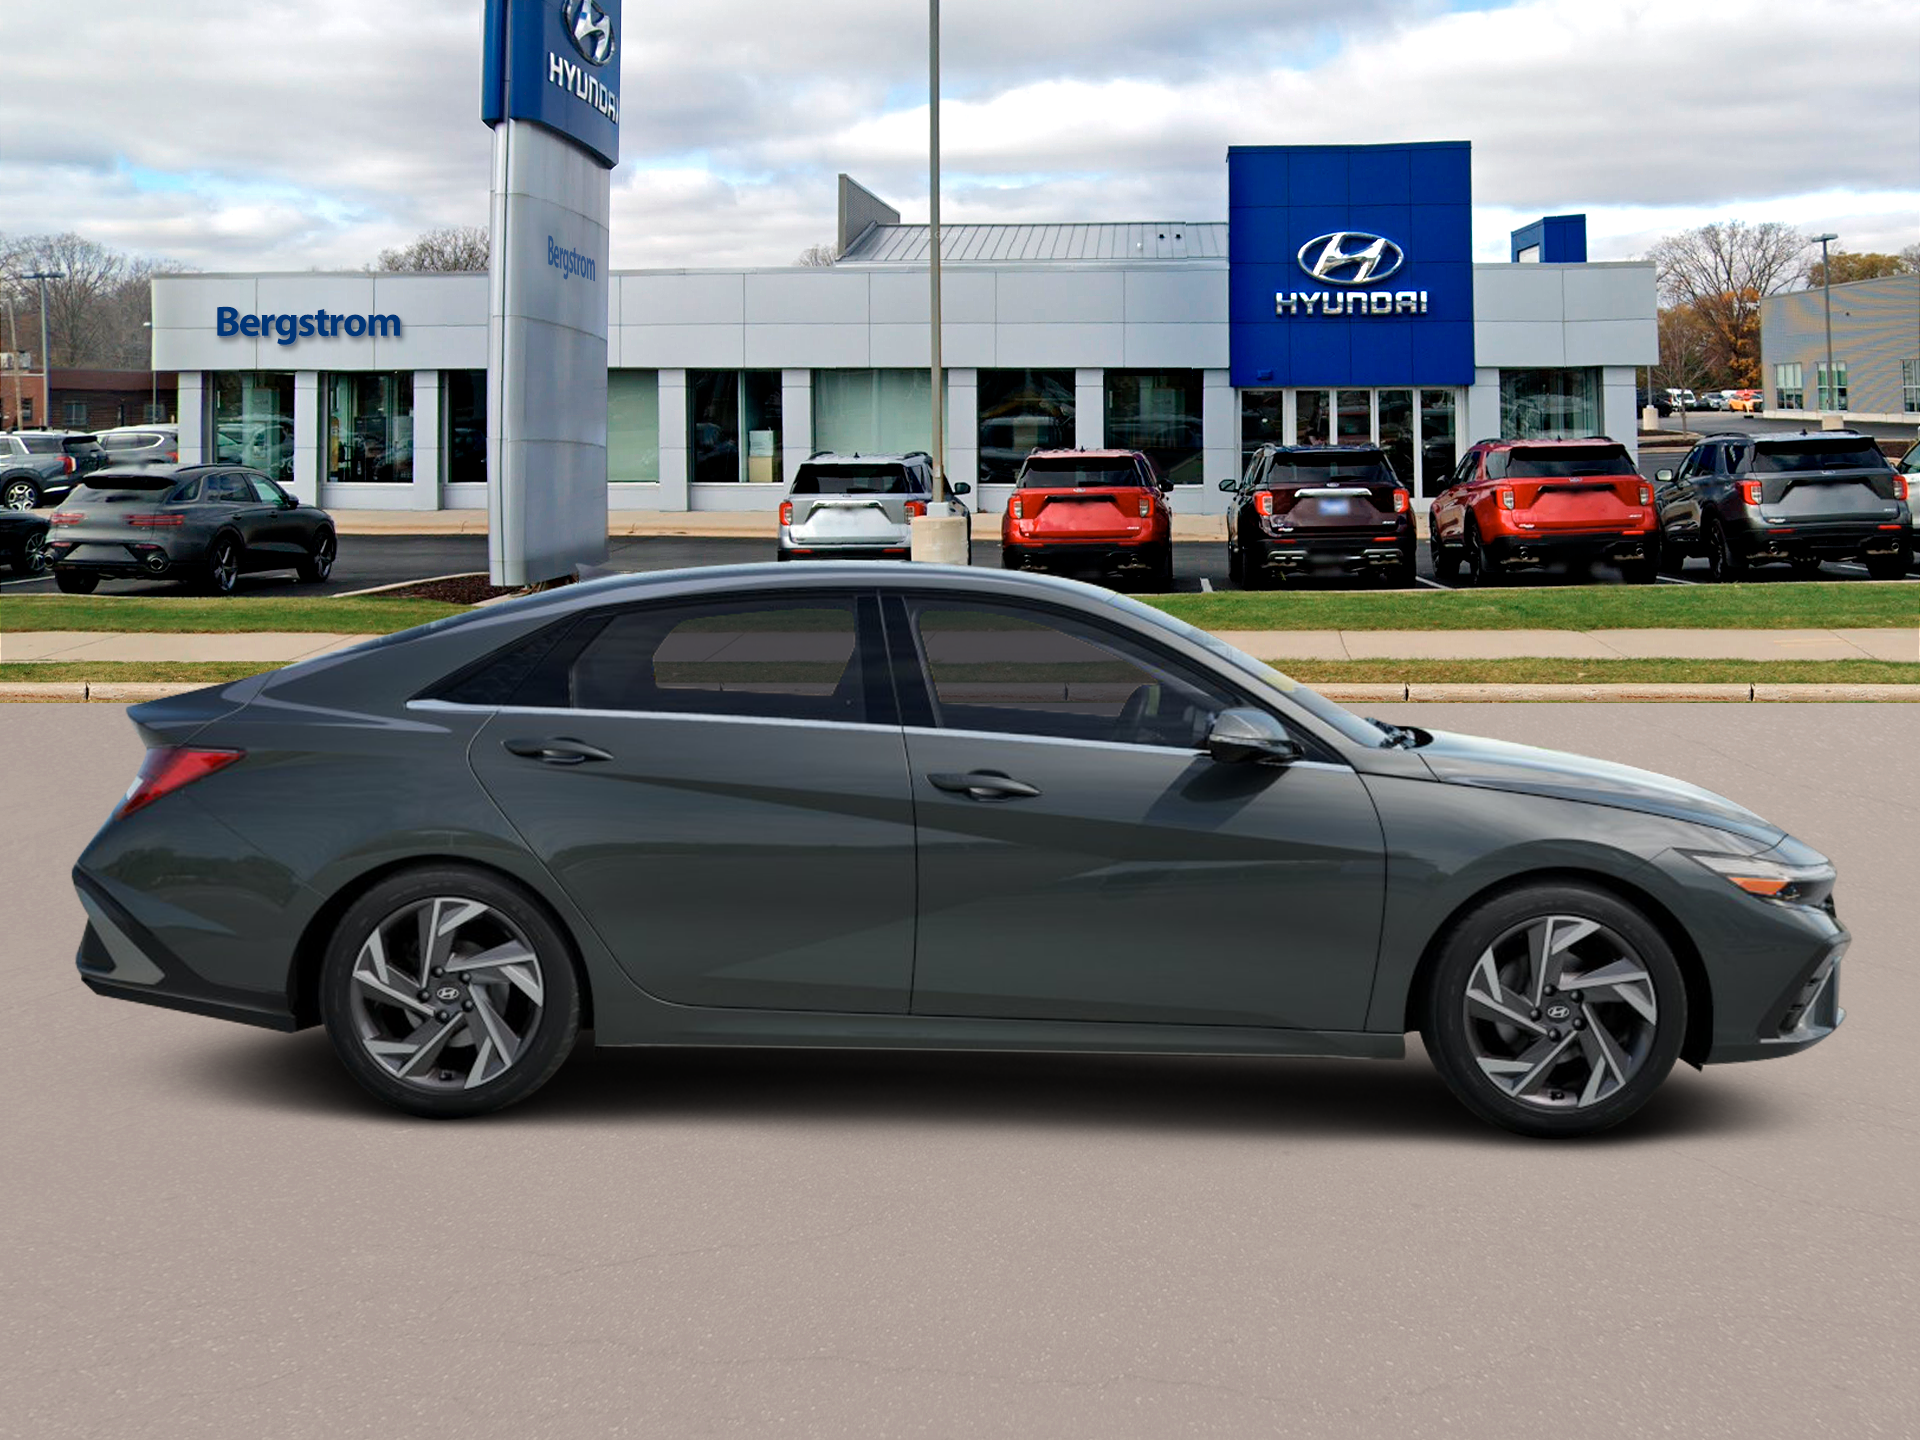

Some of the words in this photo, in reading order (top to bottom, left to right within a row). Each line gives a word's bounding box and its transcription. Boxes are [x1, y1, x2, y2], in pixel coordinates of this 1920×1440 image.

[549, 51, 619, 124] HYUNDAI
[547, 235, 596, 282] Bergstrom
[1275, 291, 1428, 315] HYUNDAI
[216, 306, 402, 346] Bergstrom
